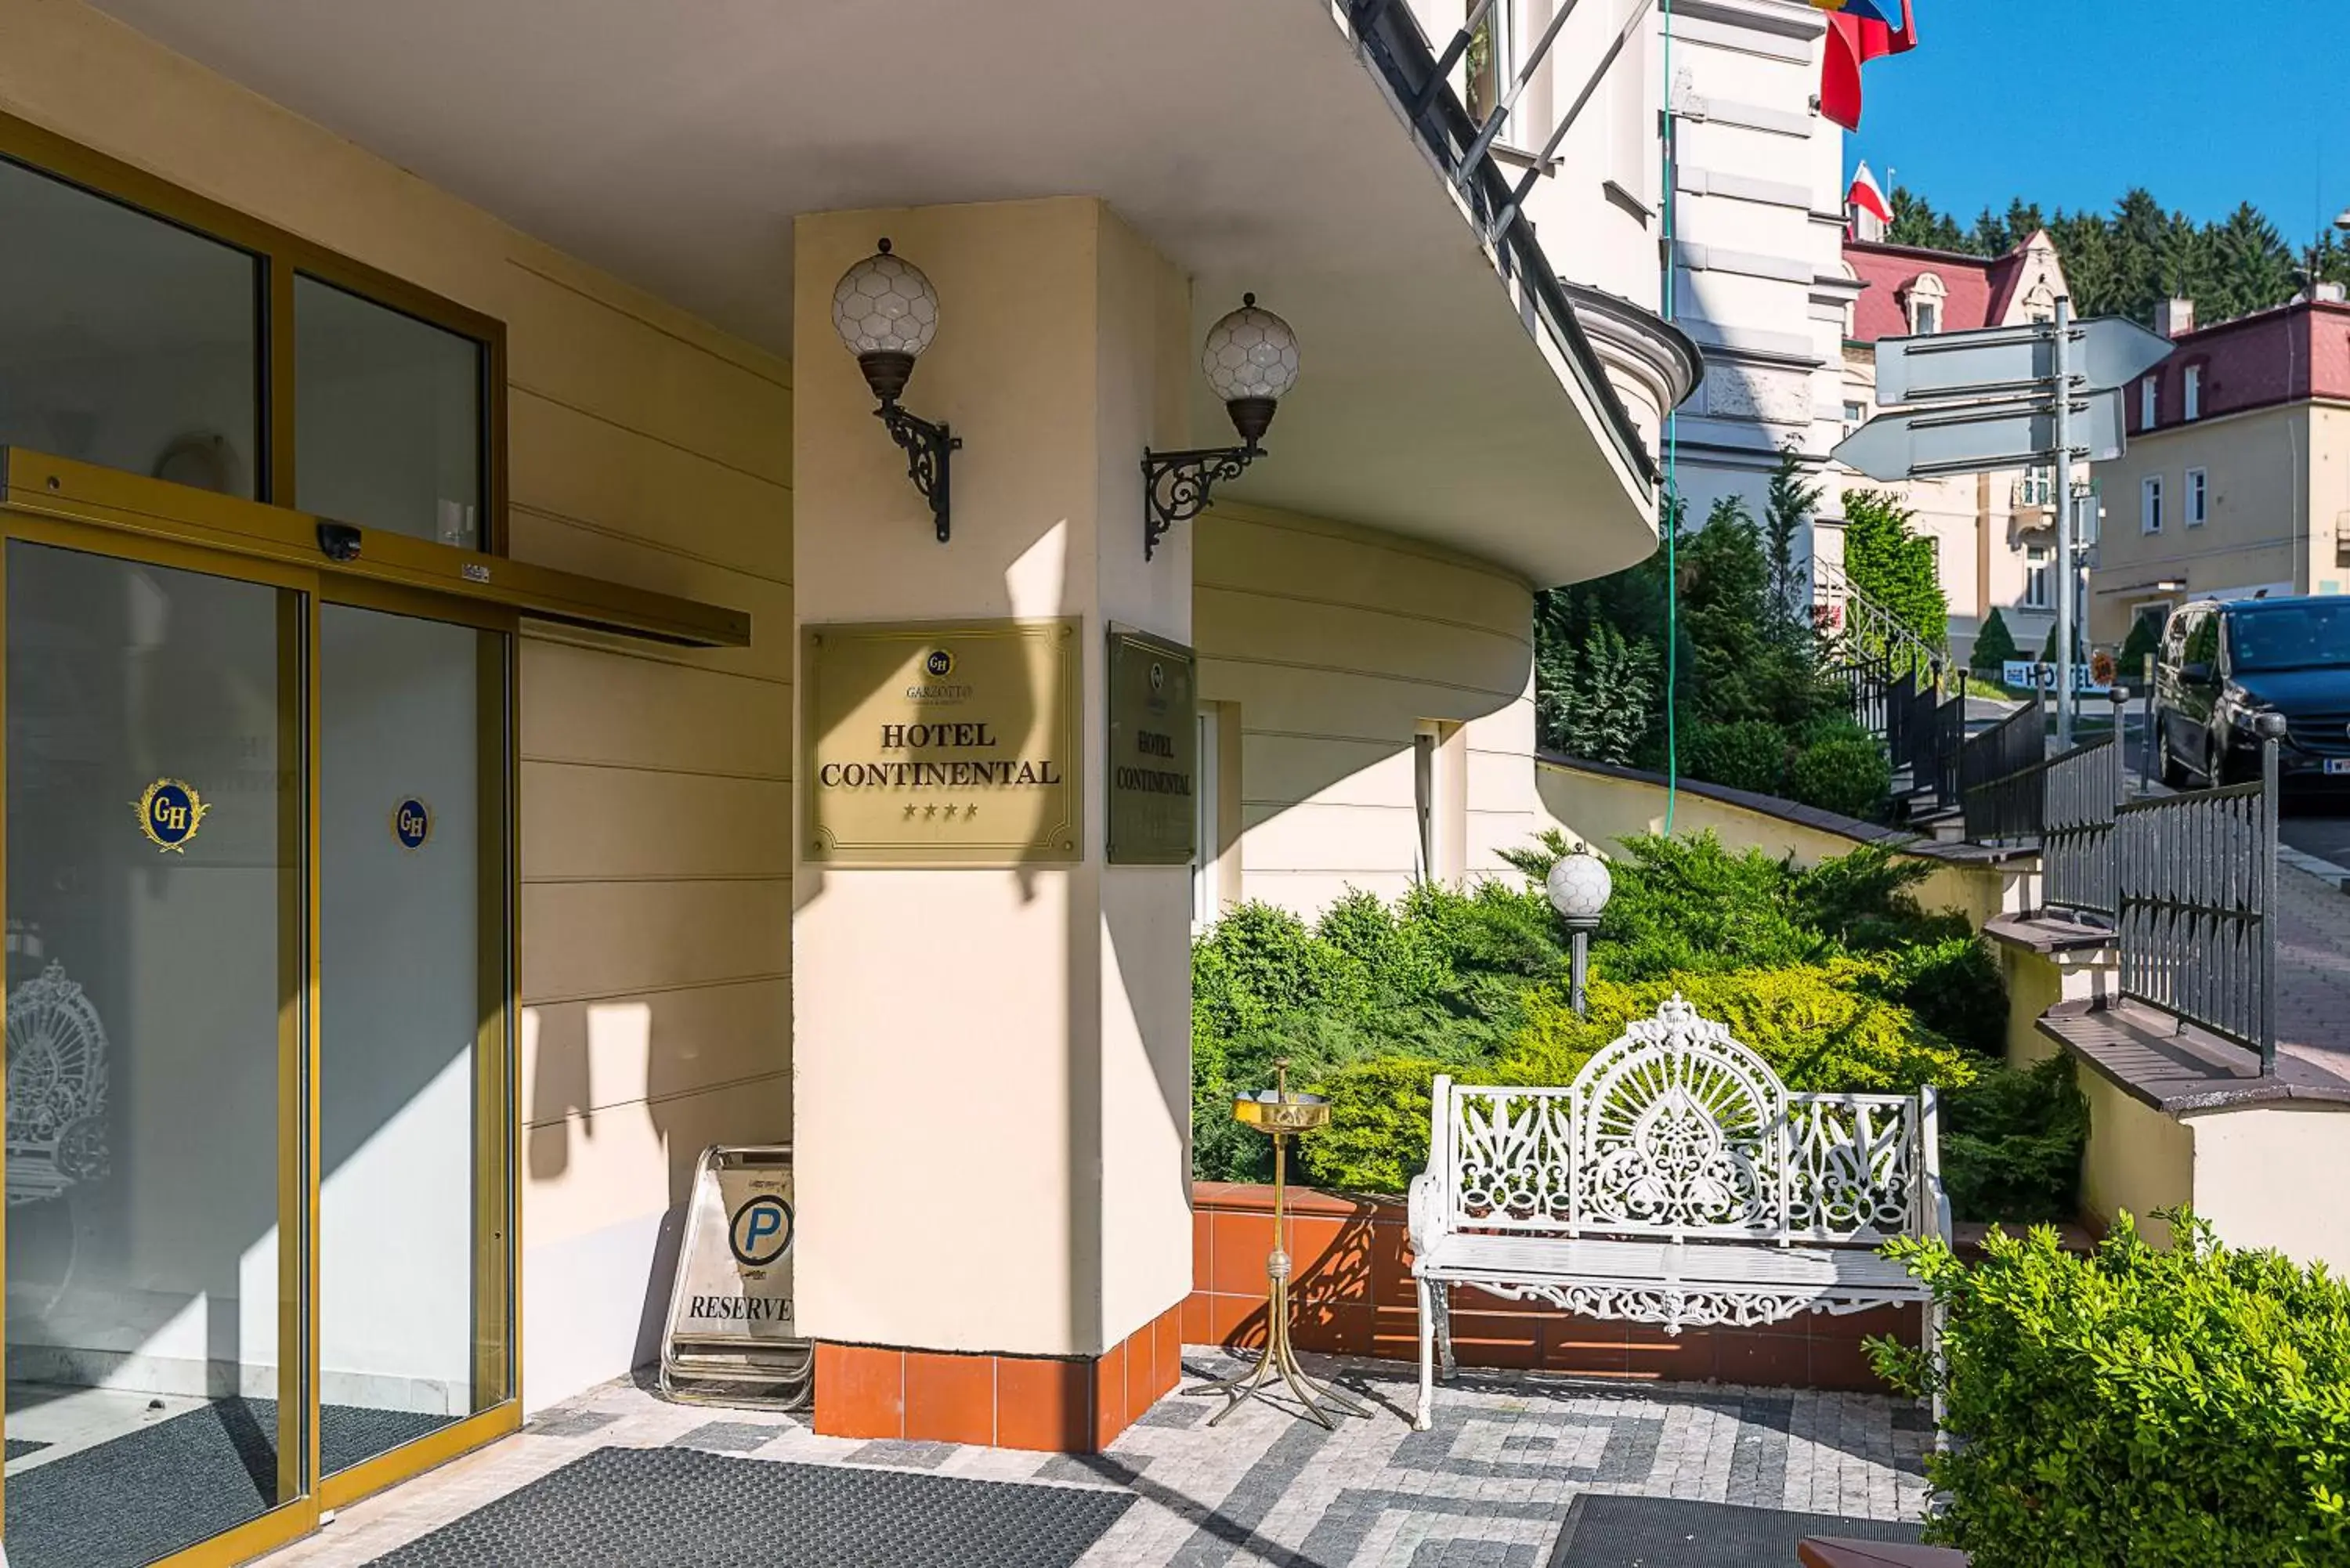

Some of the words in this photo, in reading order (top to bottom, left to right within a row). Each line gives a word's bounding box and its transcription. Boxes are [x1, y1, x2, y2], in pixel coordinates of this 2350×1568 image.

[930, 656, 947, 672] GH
[881, 723, 996, 749] HOTEL
[1138, 729, 1174, 758] HOTEL
[820, 762, 1061, 787] CONTINENTAL
[1117, 765, 1191, 797] CONTINENTAL
[154, 796, 187, 829] GH
[400, 809, 424, 836] GH
[749, 1207, 782, 1252] P
[689, 1296, 794, 1321] RESERVE
